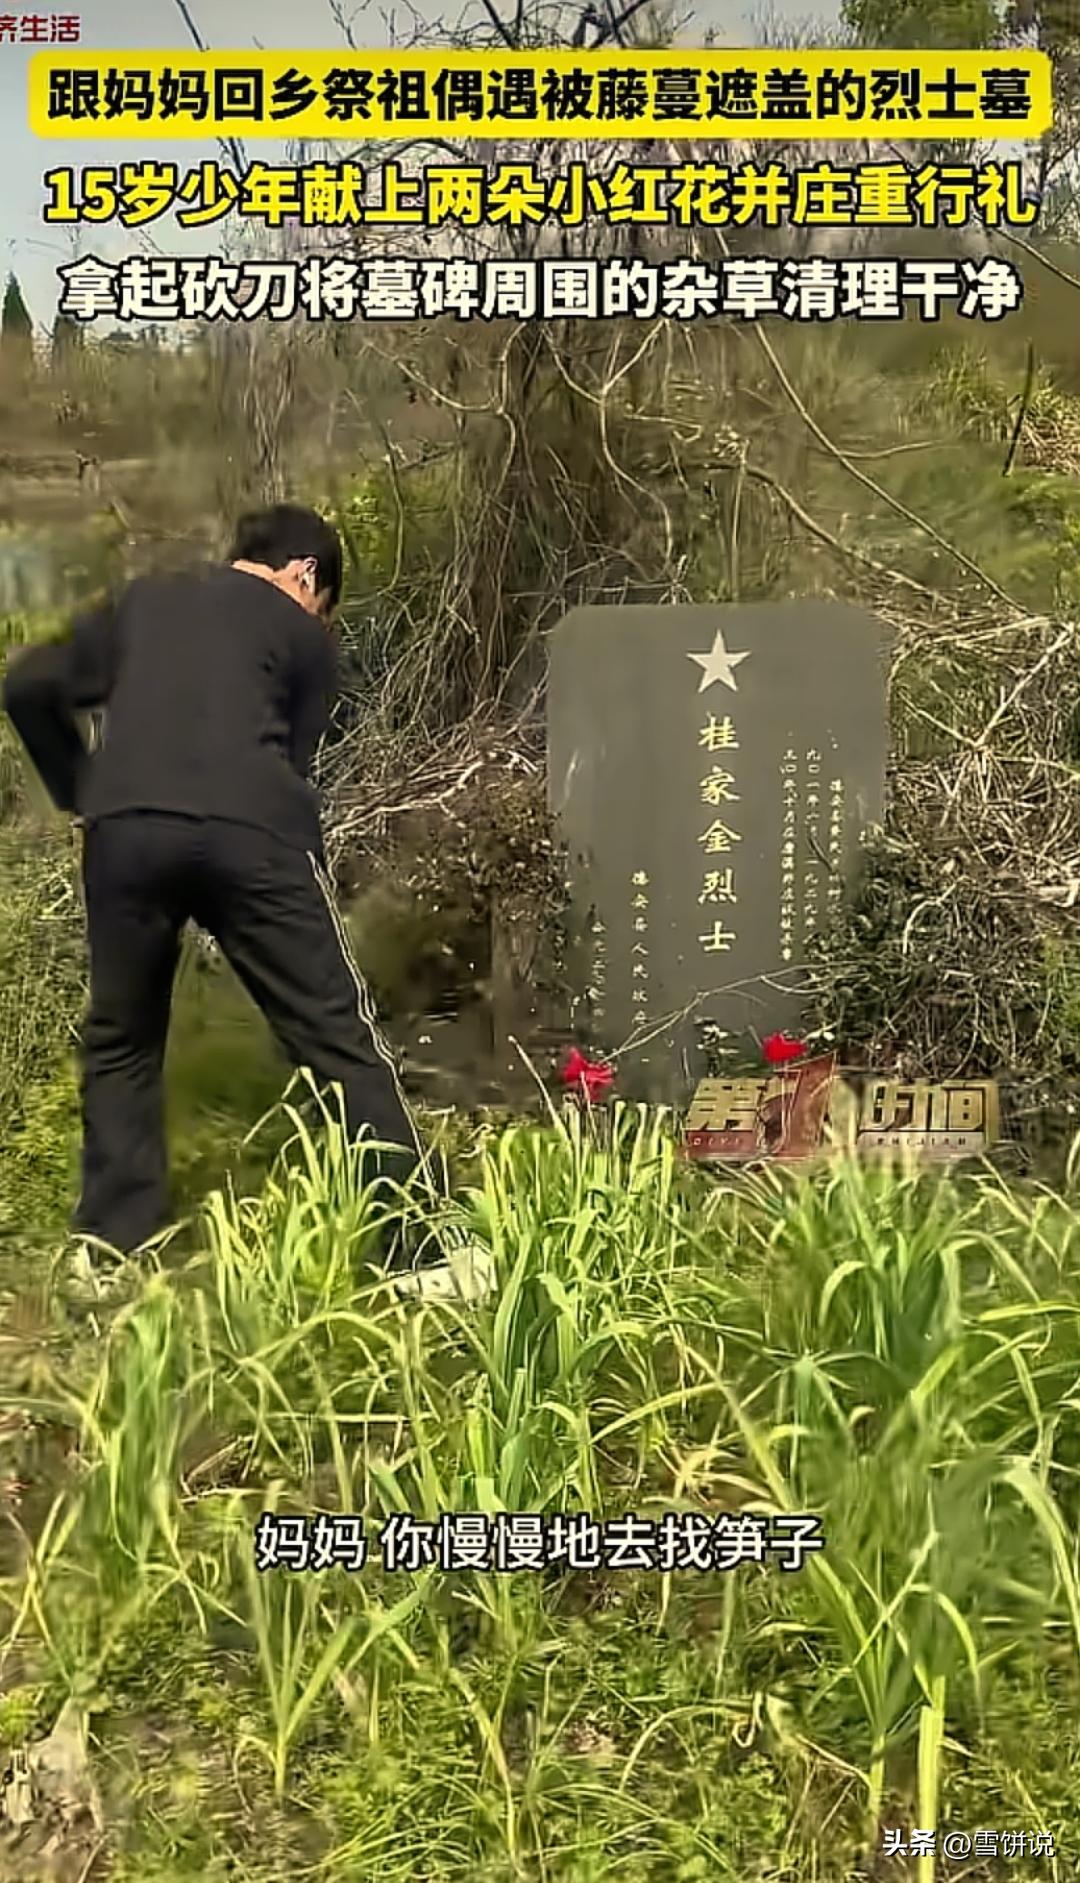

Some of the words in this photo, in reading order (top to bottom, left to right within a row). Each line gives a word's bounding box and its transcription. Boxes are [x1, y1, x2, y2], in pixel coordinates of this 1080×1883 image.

[698, 714, 742, 952] 桂家金烈士
